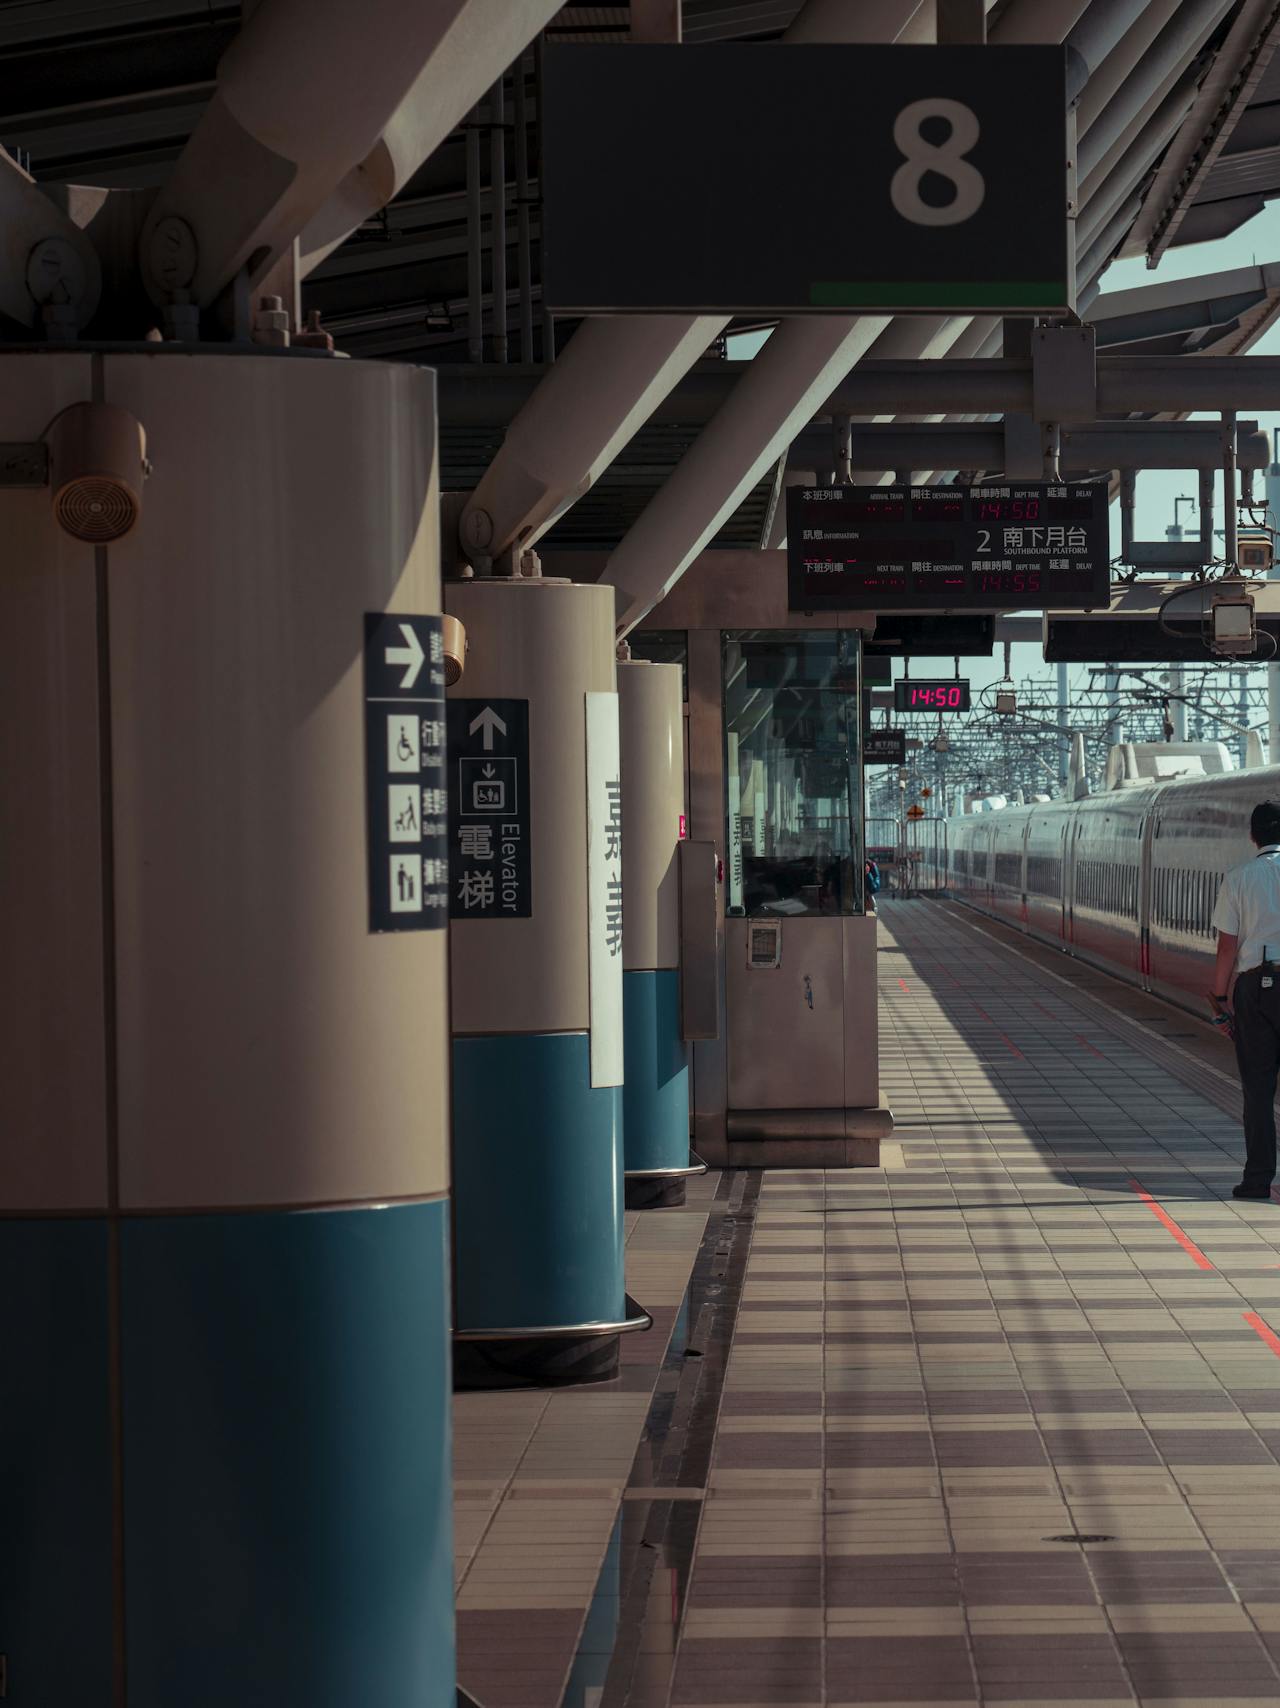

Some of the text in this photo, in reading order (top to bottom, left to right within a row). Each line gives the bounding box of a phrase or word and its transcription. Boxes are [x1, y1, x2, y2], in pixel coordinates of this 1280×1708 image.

[890, 96, 986, 227] 8
[802, 489, 843, 501] 本班列車
[910, 488, 931, 499] 開往
[932, 492, 963, 500] DESTINATION
[970, 487, 1011, 498] 開車時間
[980, 501, 1040, 520] 14:50
[976, 529, 992, 553] 2
[1003, 526, 1088, 548] 南下月台
[1003, 547, 1088, 556] SOUTHBOUND PLATFORM
[802, 562, 845, 573] 下班列車
[911, 561, 932, 572] 開往
[932, 564, 964, 572] DESTINATION
[971, 560, 1012, 571] 開車時間
[1075, 562, 1093, 570] DELAY
[981, 572, 1040, 593] 14:55
[911, 687, 961, 707] 14:50
[457, 823, 496, 911] 電梯
[501, 822, 521, 912] Elevator
